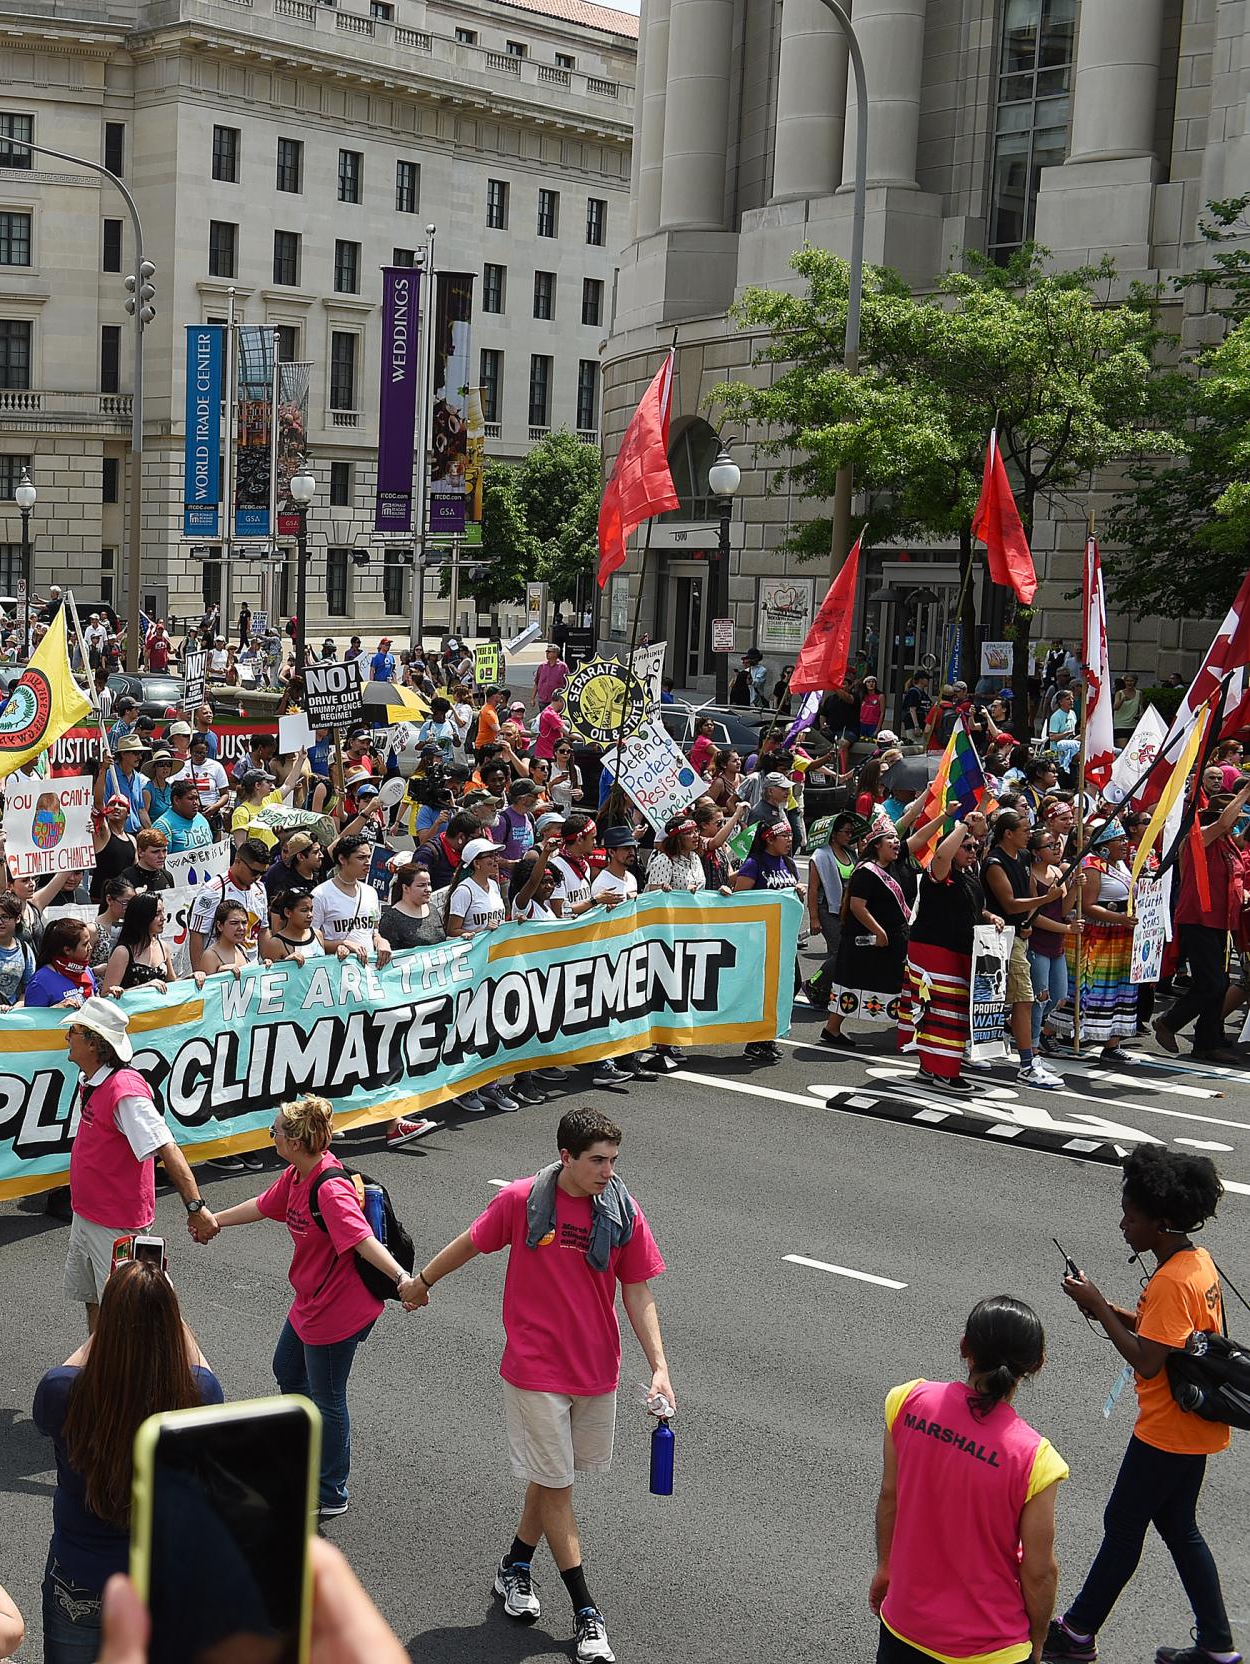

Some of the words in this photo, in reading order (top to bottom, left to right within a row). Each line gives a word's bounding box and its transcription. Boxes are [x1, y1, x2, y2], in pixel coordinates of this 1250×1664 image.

[392, 279, 409, 382] WEDDINGS
[197, 333, 210, 391] CENTER
[196, 394, 209, 434] TRADE
[195, 435, 209, 500] WORLD
[187, 653, 206, 680] NO!
[305, 664, 357, 695] NO!
[569, 663, 619, 702] SEPARATE
[308, 695, 338, 707] DRIVE
[341, 691, 360, 703] OUT
[309, 701, 362, 715] TRUMP/PENCE
[320, 711, 352, 721] REGIME!
[590, 728, 610, 741] OIL
[612, 730, 620, 740] &
[623, 700, 644, 736] STATE
[608, 726, 667, 778] Defend
[623, 747, 677, 794] Protect
[6, 794, 32, 811] YOU
[634, 768, 680, 810] Resist
[647, 789, 693, 829] Renew
[8, 850, 54, 875] CLIMATE
[58, 845, 95, 870] CHANGE
[372, 878, 385, 890] EPA
[221, 973, 288, 1021] WE
[301, 965, 386, 1010] ARE
[398, 943, 473, 994] THE
[167, 998, 446, 1111] CLIMATE
[454, 940, 722, 1047] MOVEMENT
[974, 1003, 1005, 1014] PROTECT
[562, 1223, 588, 1234] March
[904, 1413, 1001, 1468] MARSHALL
